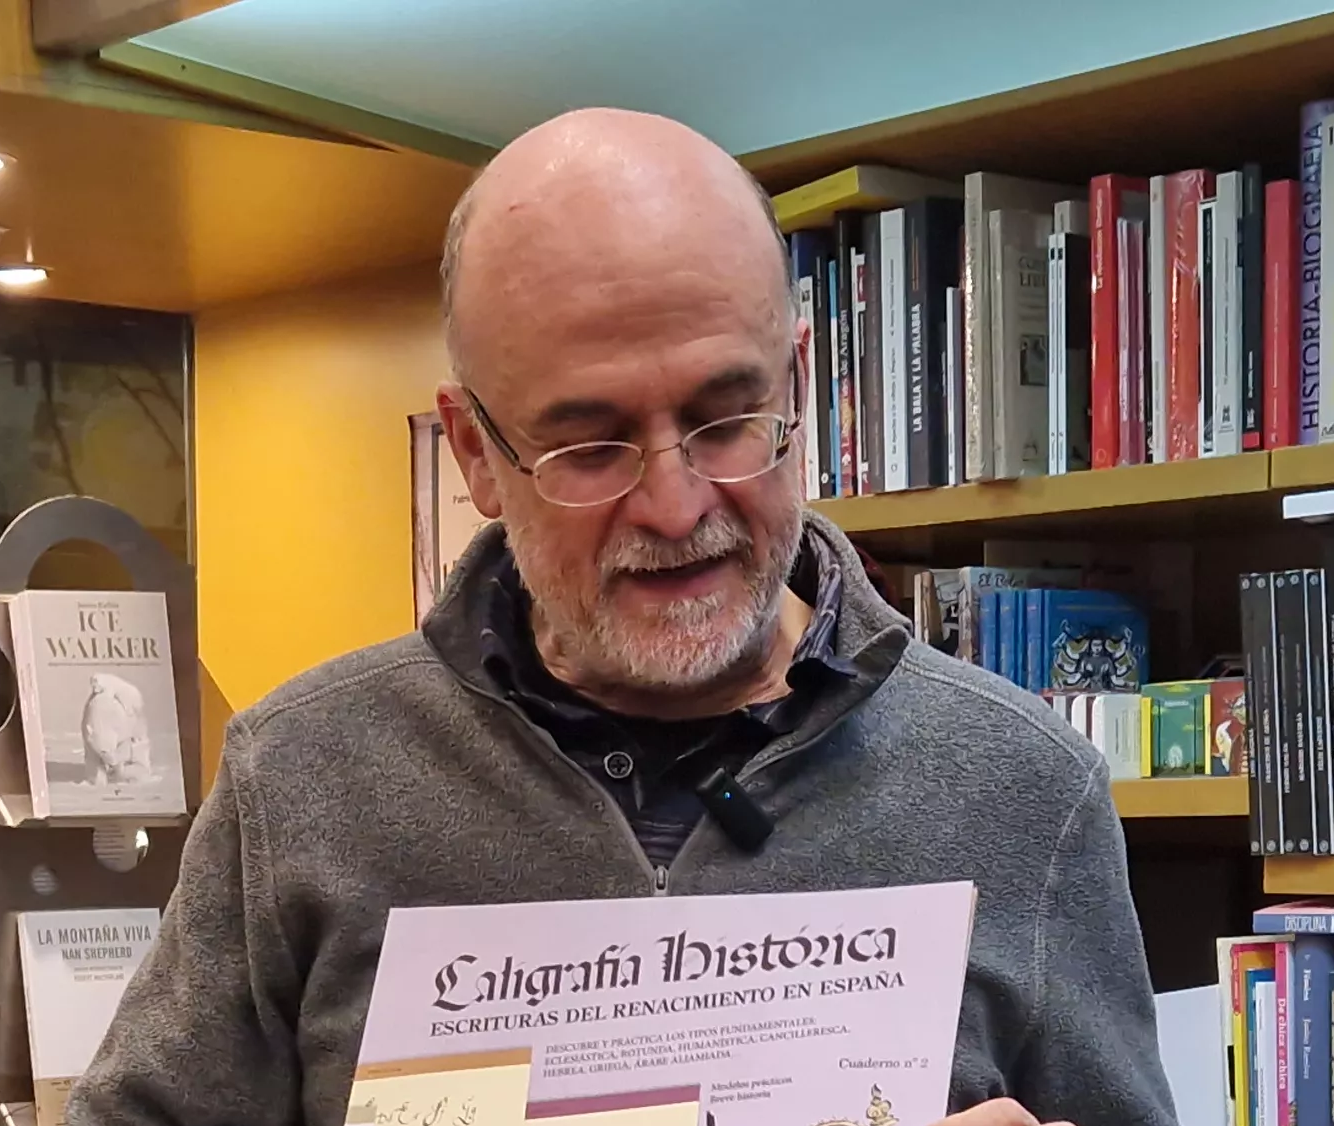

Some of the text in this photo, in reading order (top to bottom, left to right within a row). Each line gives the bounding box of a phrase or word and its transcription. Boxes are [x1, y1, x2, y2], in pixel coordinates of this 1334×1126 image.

[911, 356, 922, 373] LA
[912, 415, 923, 433] LA
[78, 610, 123, 632] ICE
[46, 637, 159, 659] WALKER
[37, 924, 152, 945] LA MONTAÑA VIVA
[84, 946, 132, 960] SHEPHERD
[432, 924, 897, 1012] Caligrafía Histórica
[429, 970, 906, 1037] ESCRITURAS DEL RENACIMIENTO EN ESPAÑA
[546, 1026, 719, 1055] DESCUBRE LOS TIPOS
[838, 1057, 901, 1069] Cuaderno
